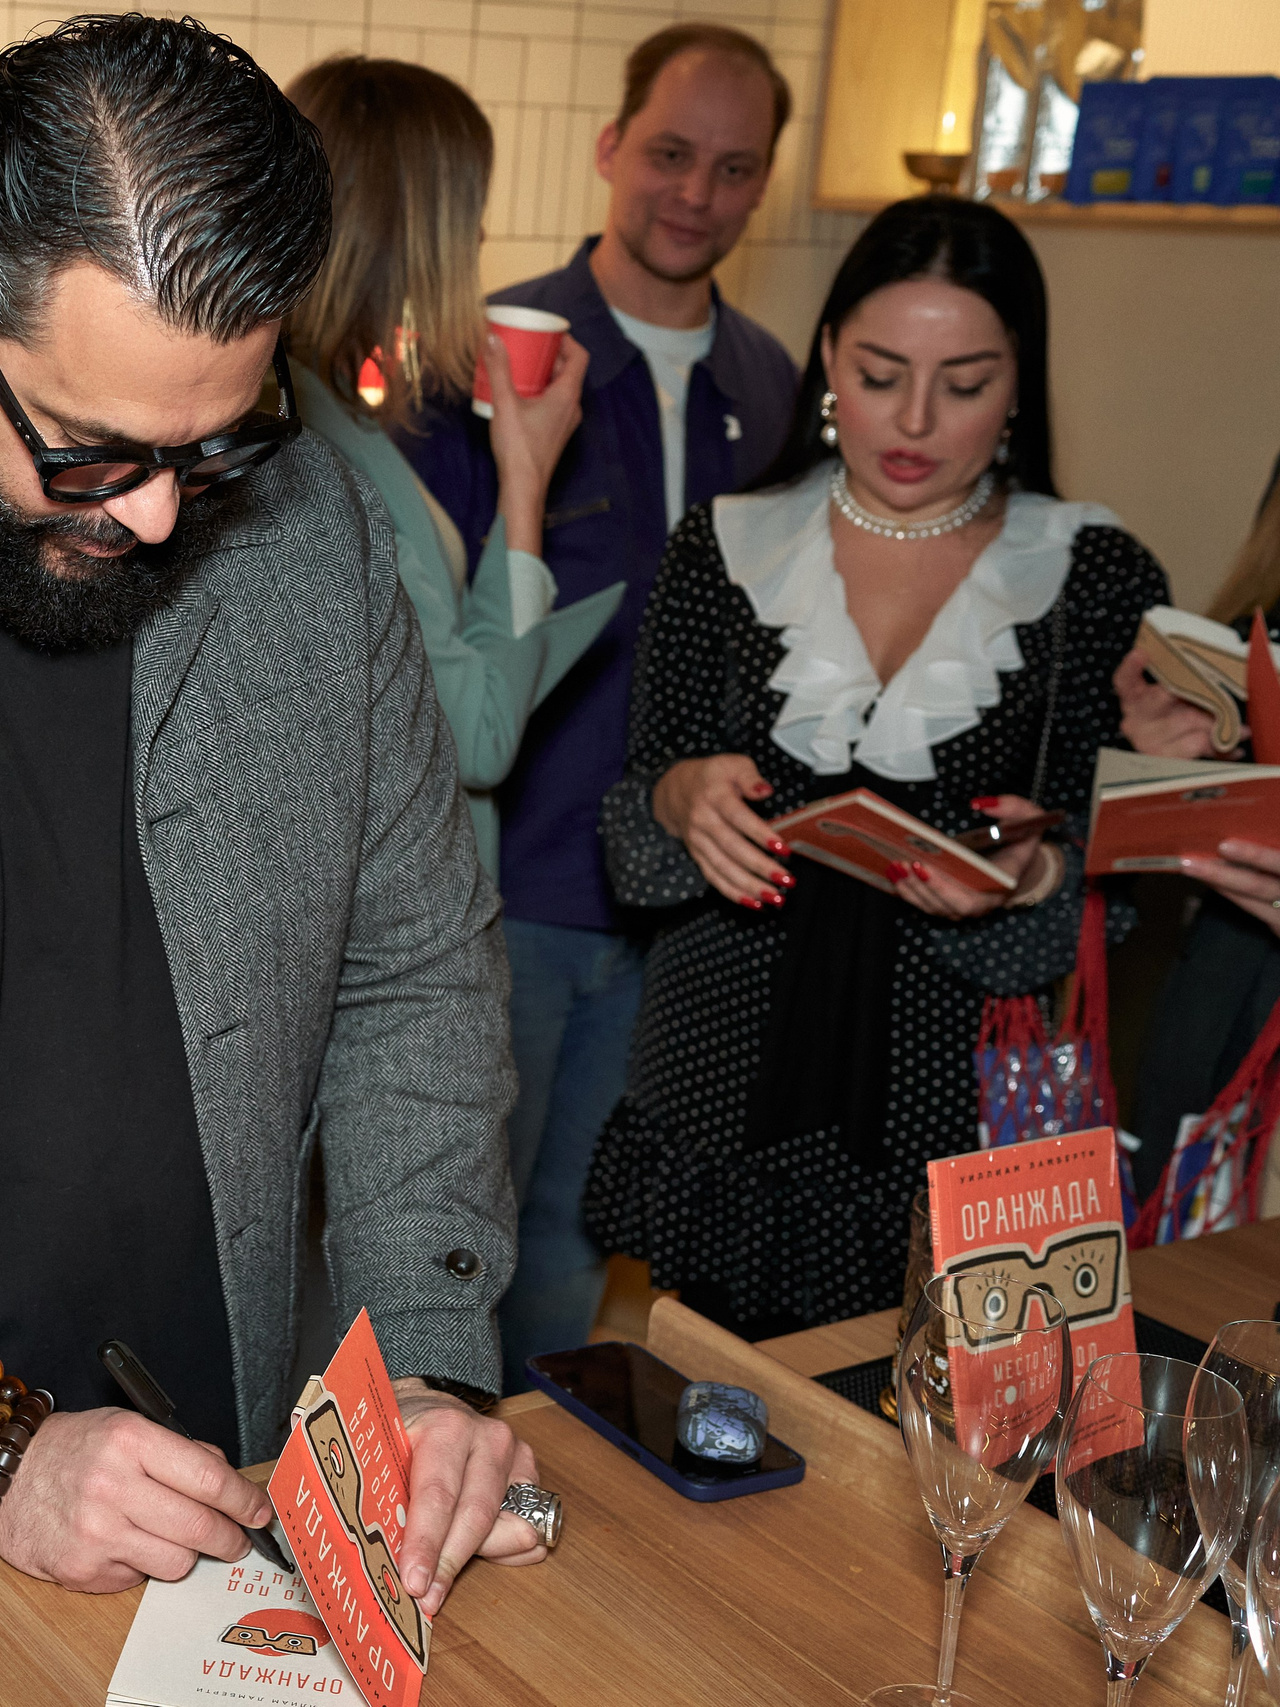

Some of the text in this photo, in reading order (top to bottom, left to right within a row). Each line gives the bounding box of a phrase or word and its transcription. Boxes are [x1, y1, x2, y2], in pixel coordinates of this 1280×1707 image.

[961, 1178, 1101, 1241] ОРАНЖАДА
[349, 1411, 371, 1469] ПОД
[227, 1579, 269, 1597] ПОД
[296, 1475, 395, 1691] ОРАНЖАДА
[203, 1659, 343, 1694] ОРАНЖАДА
[337, 1623, 388, 1707] ИЛЛИАМ
[196, 1687, 264, 1702] ЛАМБЕРТИ
